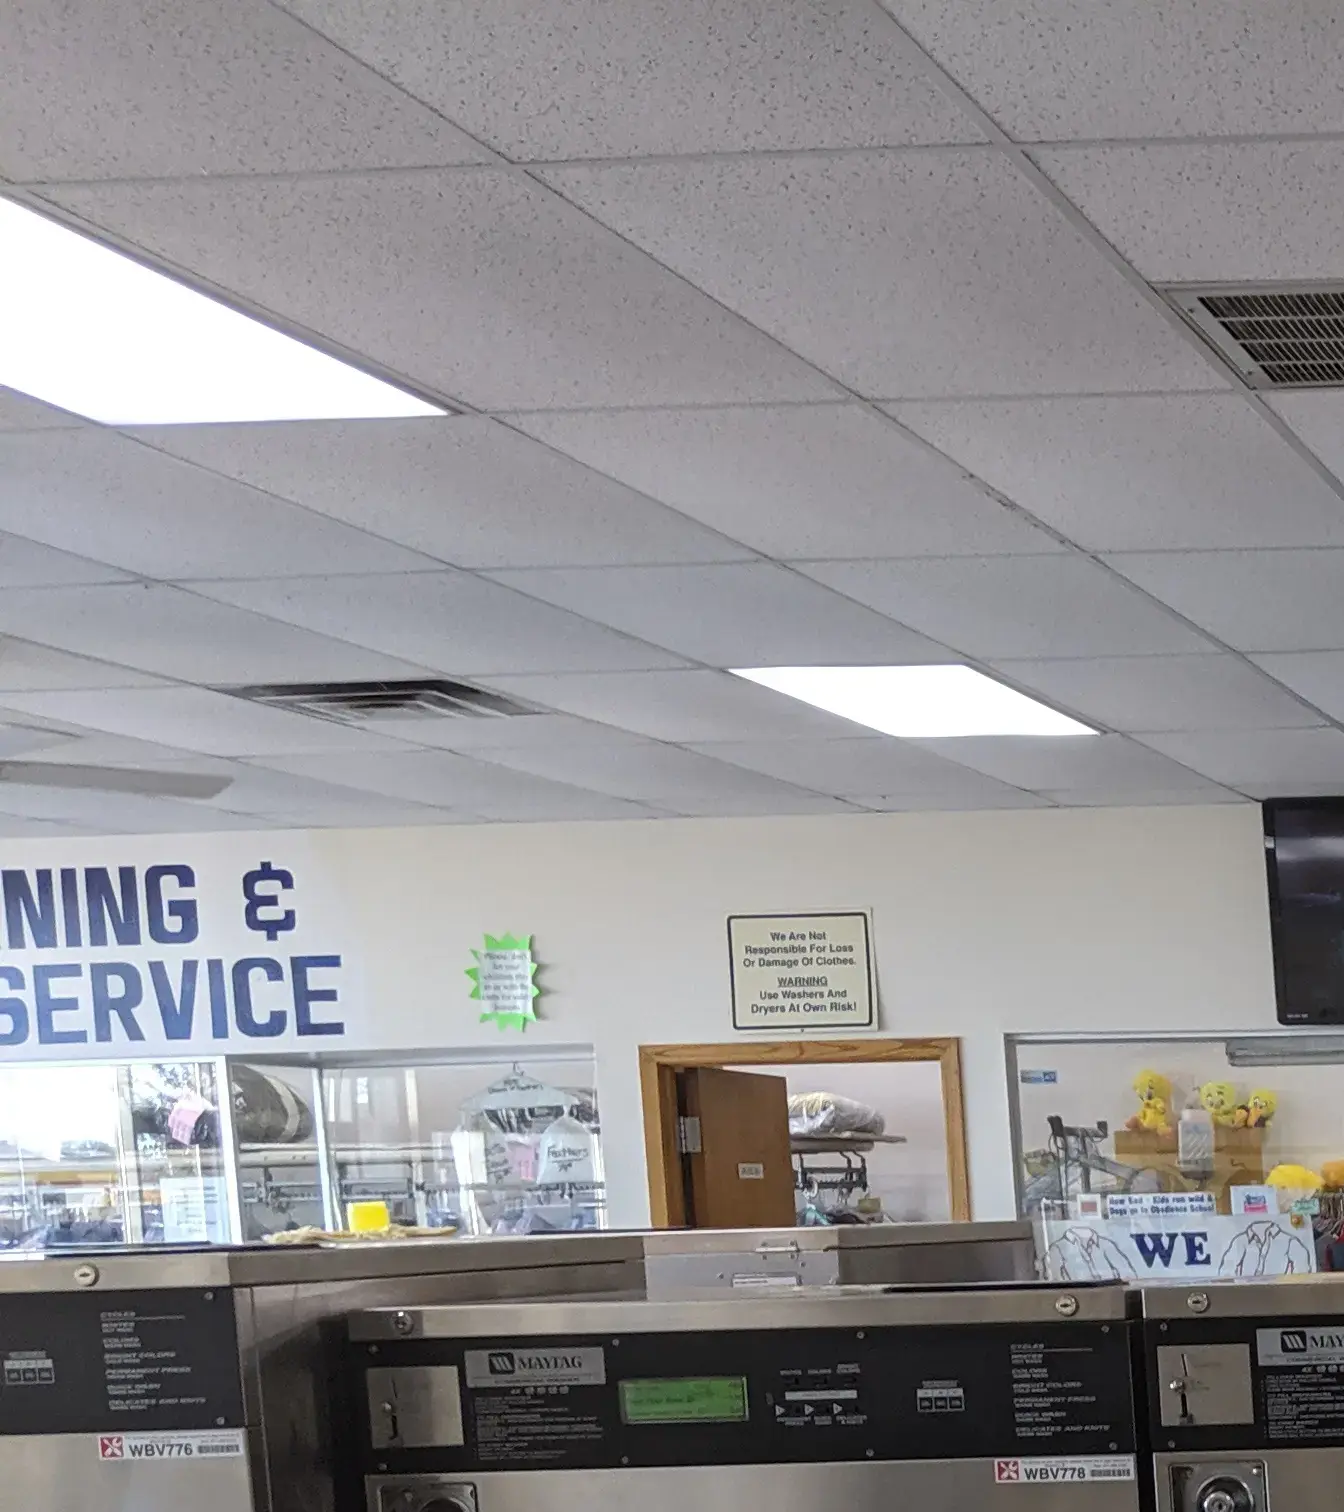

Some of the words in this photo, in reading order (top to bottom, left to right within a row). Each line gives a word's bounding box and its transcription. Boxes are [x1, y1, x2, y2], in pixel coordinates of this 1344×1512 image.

[242, 861, 296, 941] &
[771, 932, 786, 941] We
[789, 932, 805, 940] Are
[809, 932, 826, 940] Not
[745, 944, 807, 956] Responsible
[810, 944, 826, 952] For
[830, 944, 853, 952] Loss
[743, 959, 755, 968] Or
[759, 958, 798, 968] Damage
[802, 957, 812, 965] Of
[816, 957, 856, 965] Clothes.
[778, 976, 828, 987] WARNING
[760, 990, 778, 1000] Use
[781, 989, 824, 999] Washers
[827, 989, 847, 998] And
[751, 1003, 785, 1015] Dryers
[789, 1003, 800, 1012] At
[803, 1003, 827, 1012] Own
[830, 1002, 856, 1011] Risk!
[1130, 1232, 1211, 1268] WE
[518, 1356, 582, 1370] MAYTAG
[129, 1443, 193, 1457] WBV776
[1024, 1467, 1086, 1480] WBV778
